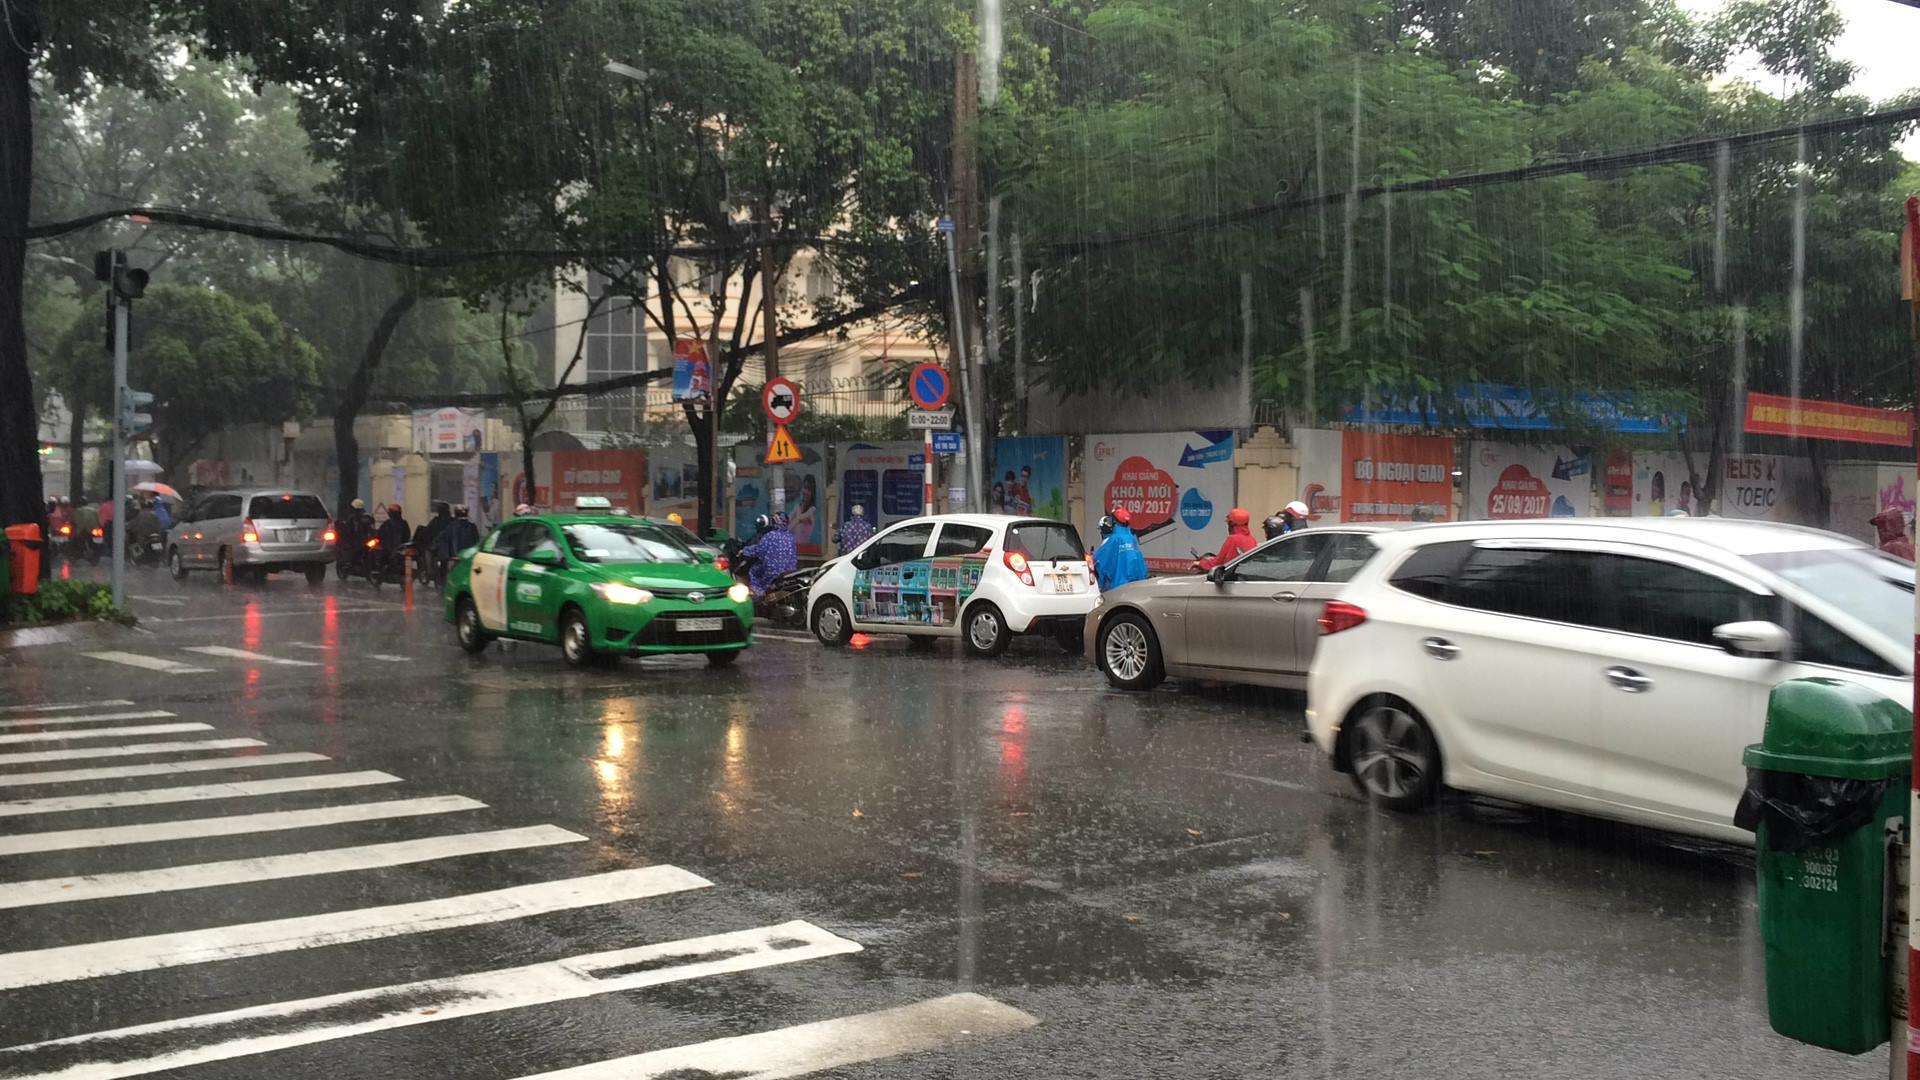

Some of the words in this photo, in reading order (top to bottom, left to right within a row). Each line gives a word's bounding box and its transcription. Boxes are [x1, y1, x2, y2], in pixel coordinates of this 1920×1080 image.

[1355, 457, 1374, 484] BỘ
[1376, 462, 1415, 484] NGOẠI
[1418, 464, 1445, 482] GIAO
[1726, 457, 1761, 480] IELTS
[1111, 482, 1144, 498] KHÓA
[1149, 482, 1172, 498] MỚI
[1736, 486, 1776, 507] TOEIC
[1493, 495, 1546, 514] 25/09/2017
